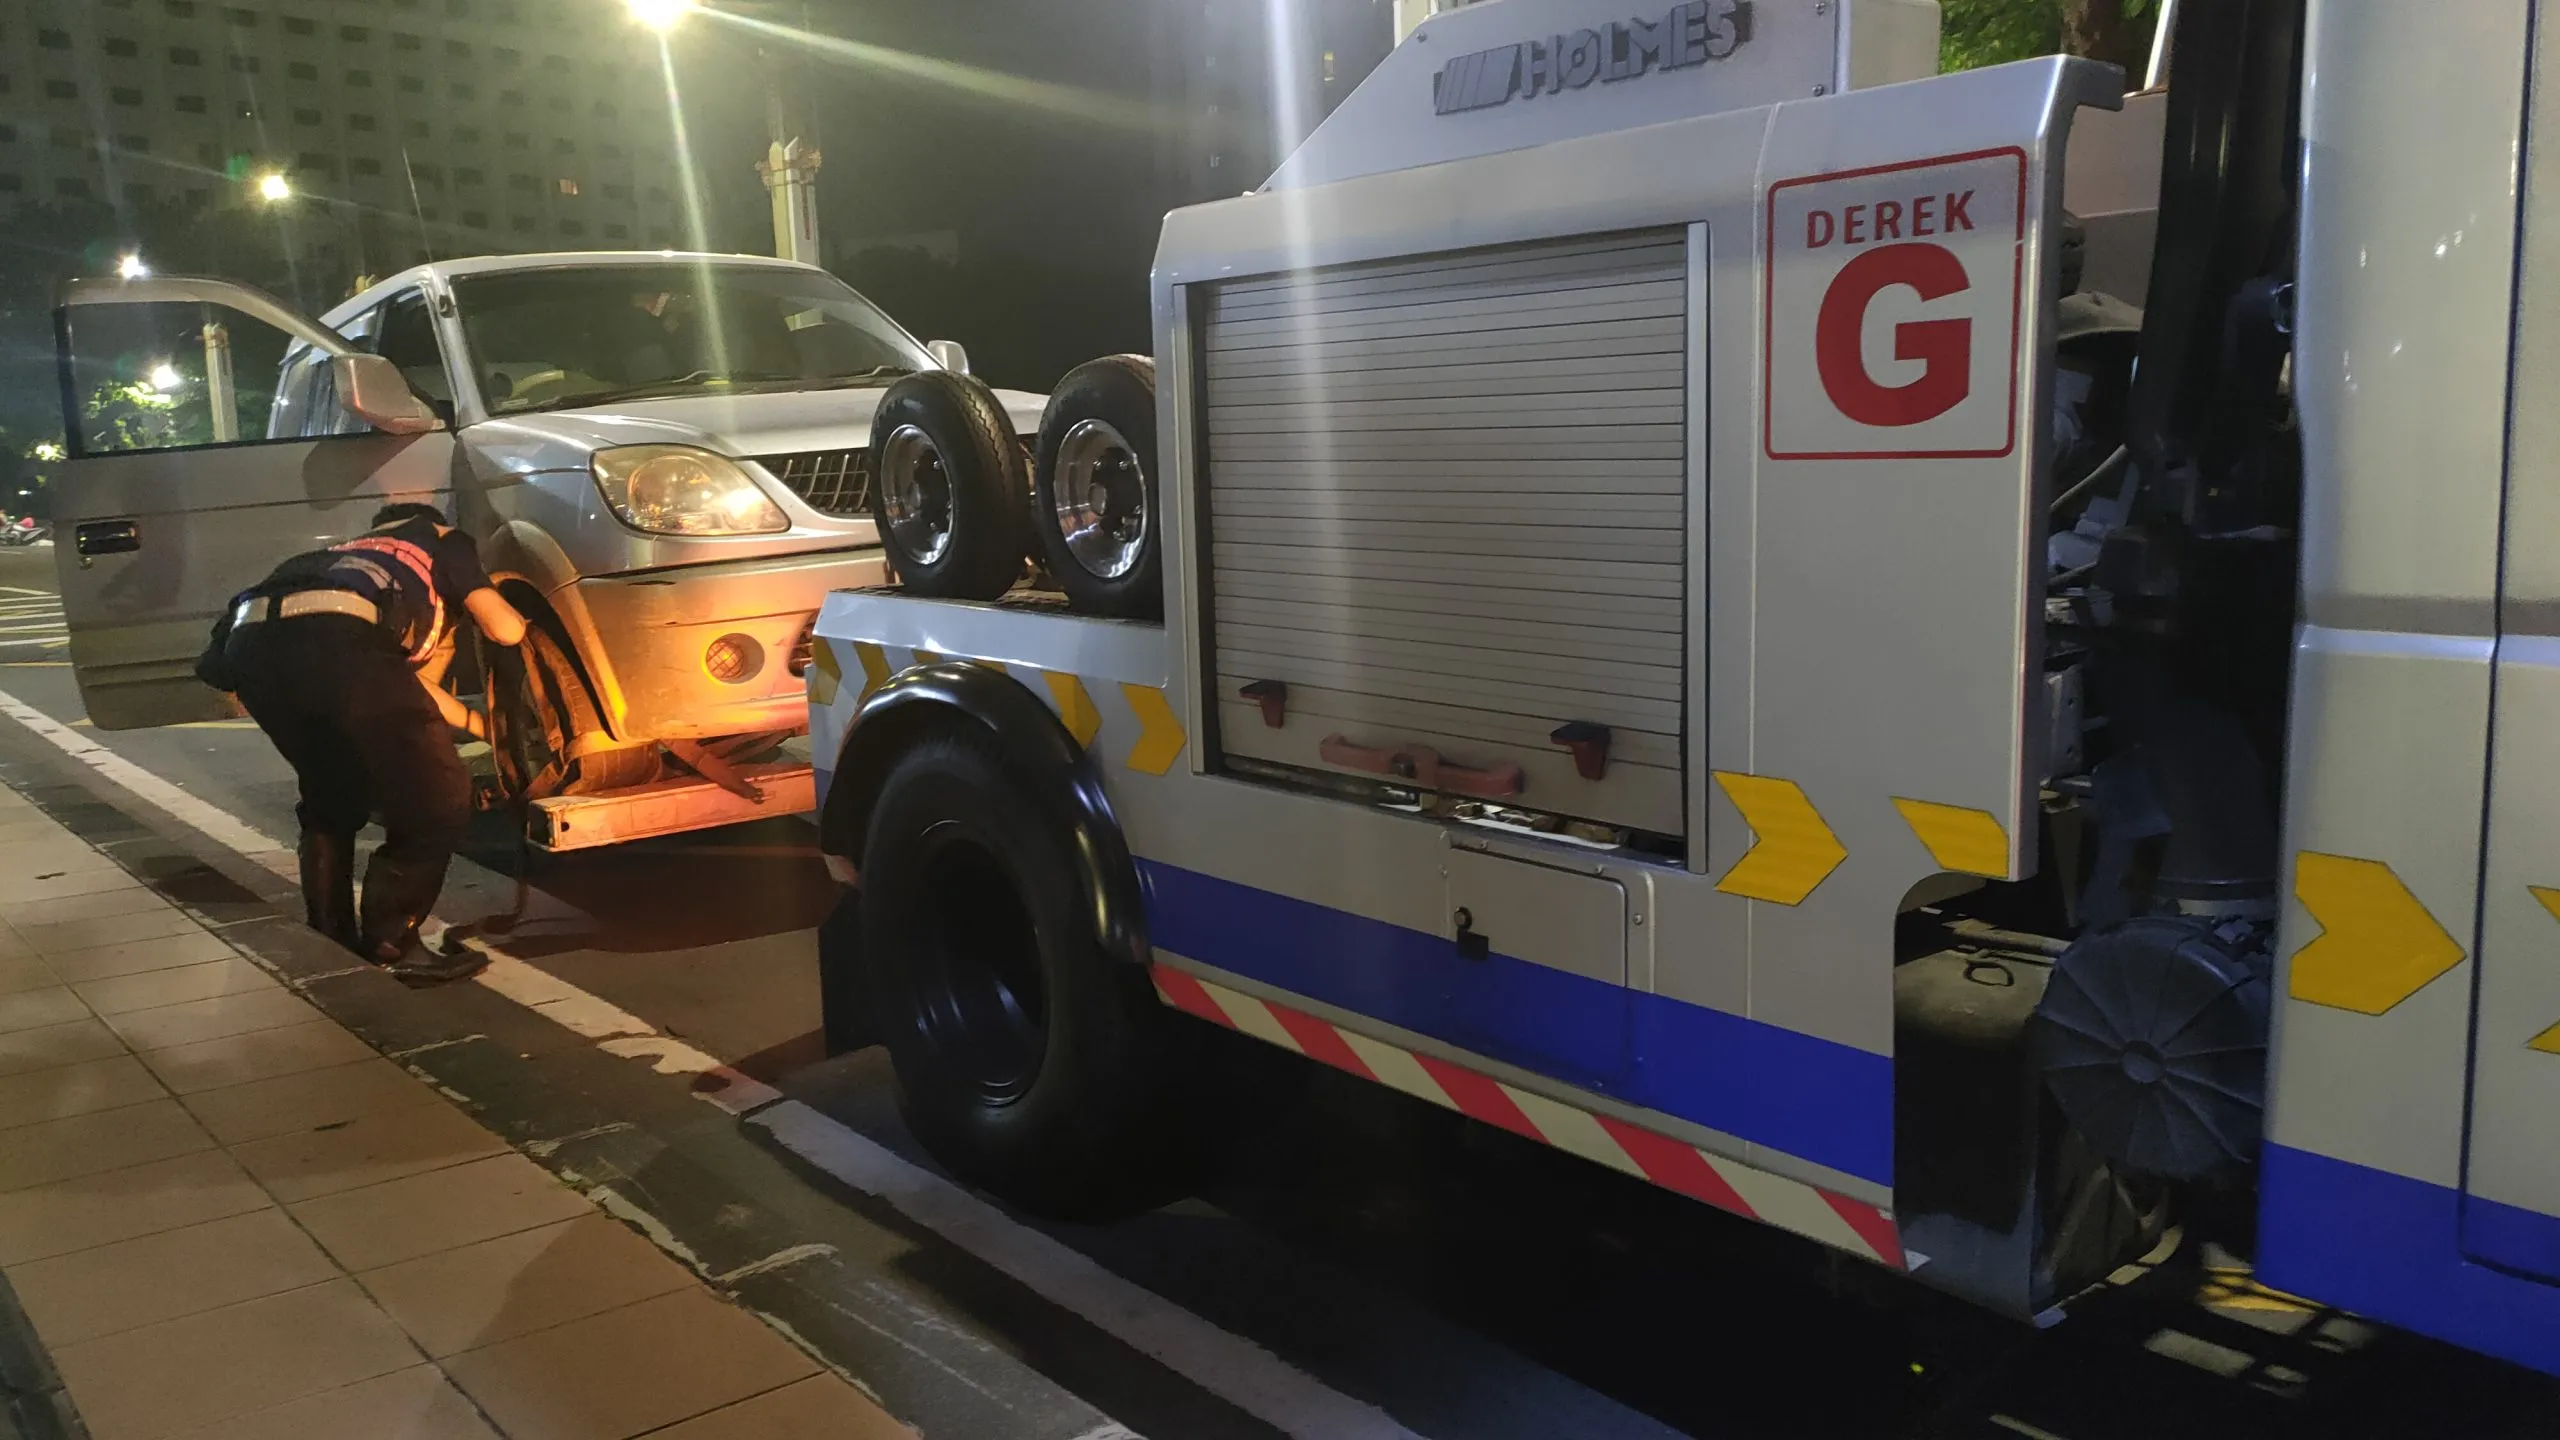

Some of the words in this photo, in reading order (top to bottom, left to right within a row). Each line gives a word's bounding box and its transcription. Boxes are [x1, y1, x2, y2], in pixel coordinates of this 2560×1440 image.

[1518, 0, 1743, 100] HOLMES
[1806, 189, 1976, 249] DEREK
[1816, 242, 1972, 427] G
